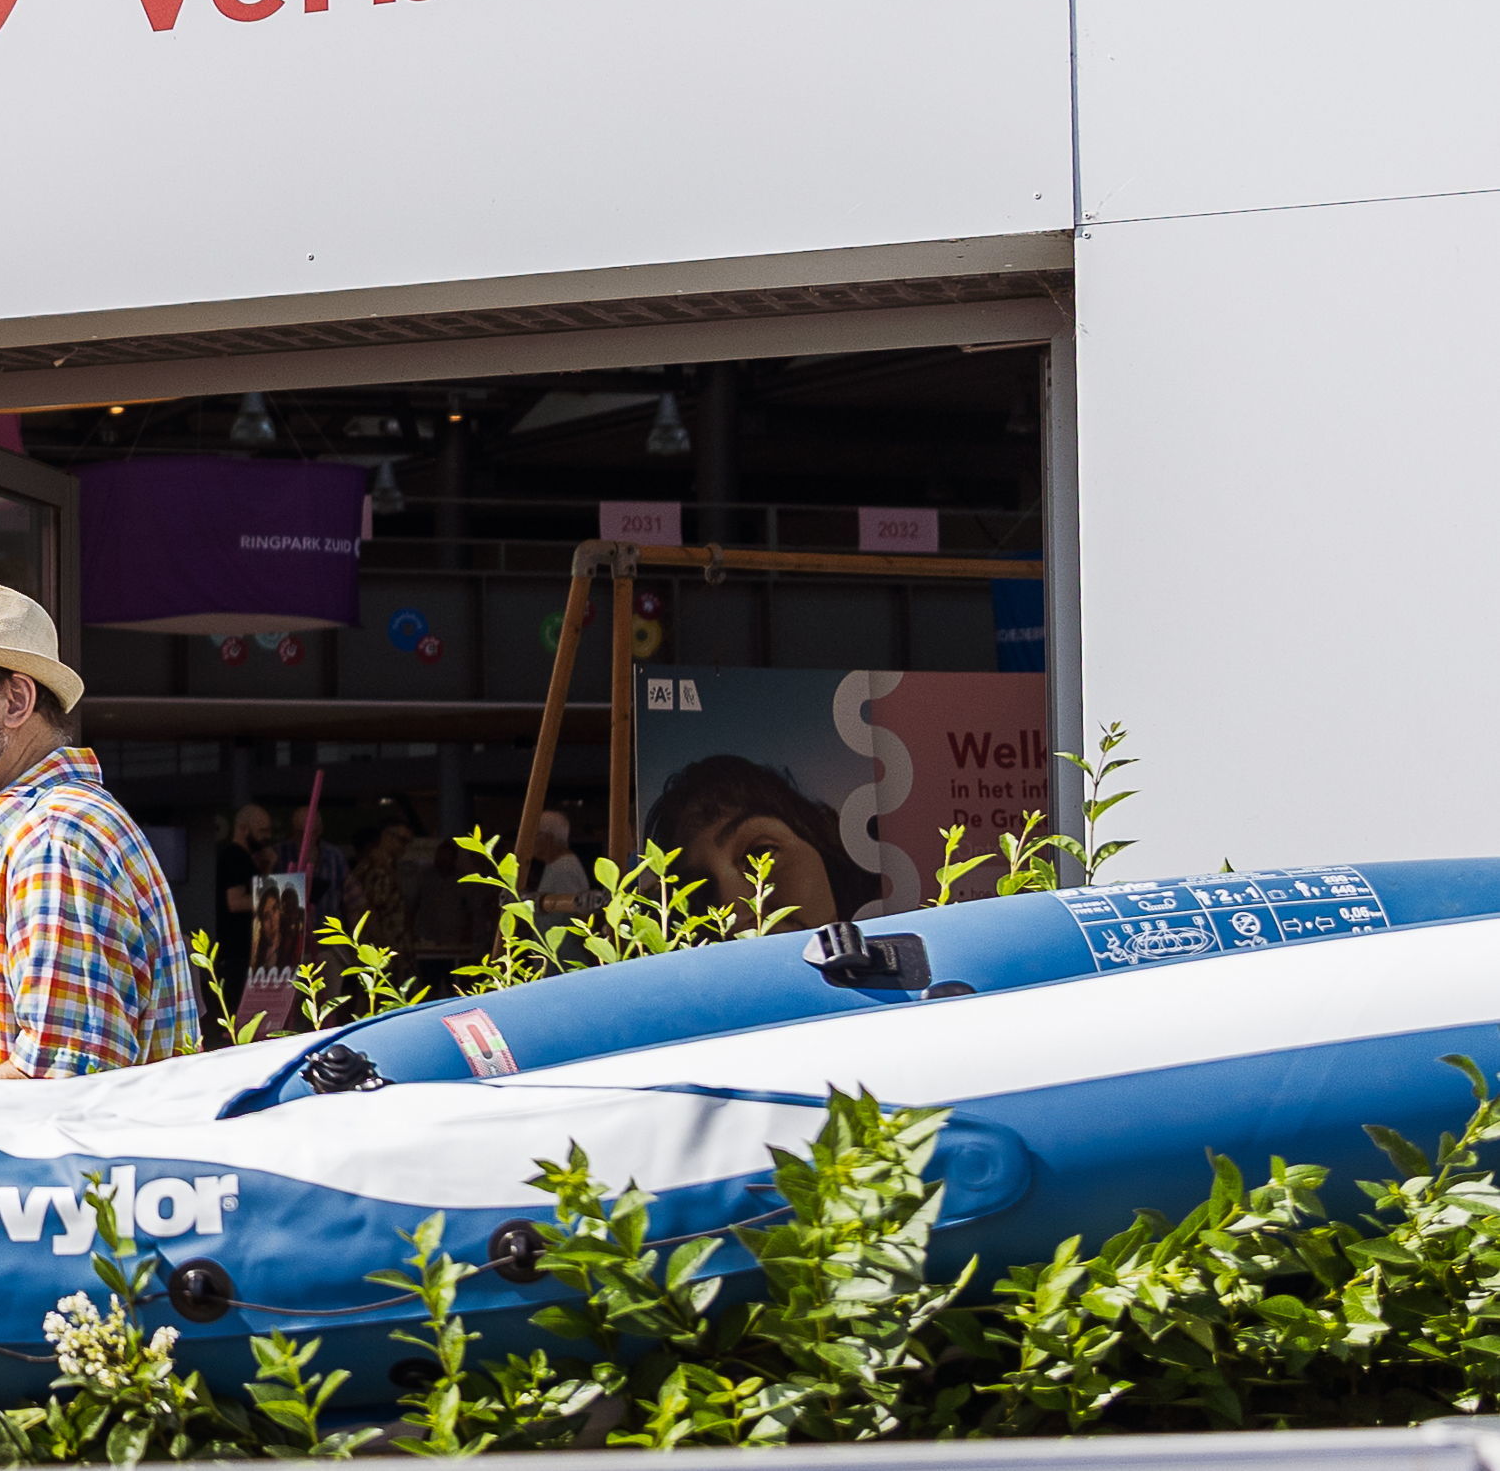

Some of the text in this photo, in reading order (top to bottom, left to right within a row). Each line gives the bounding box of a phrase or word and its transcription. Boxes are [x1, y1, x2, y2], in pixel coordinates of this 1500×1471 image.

[621, 515, 662, 533] 2031
[878, 520, 919, 539] 2032
[240, 534, 351, 553] RINGPARK ZUID
[951, 779, 969, 799] in
[978, 778, 1013, 799] het
[953, 808, 982, 829] De
